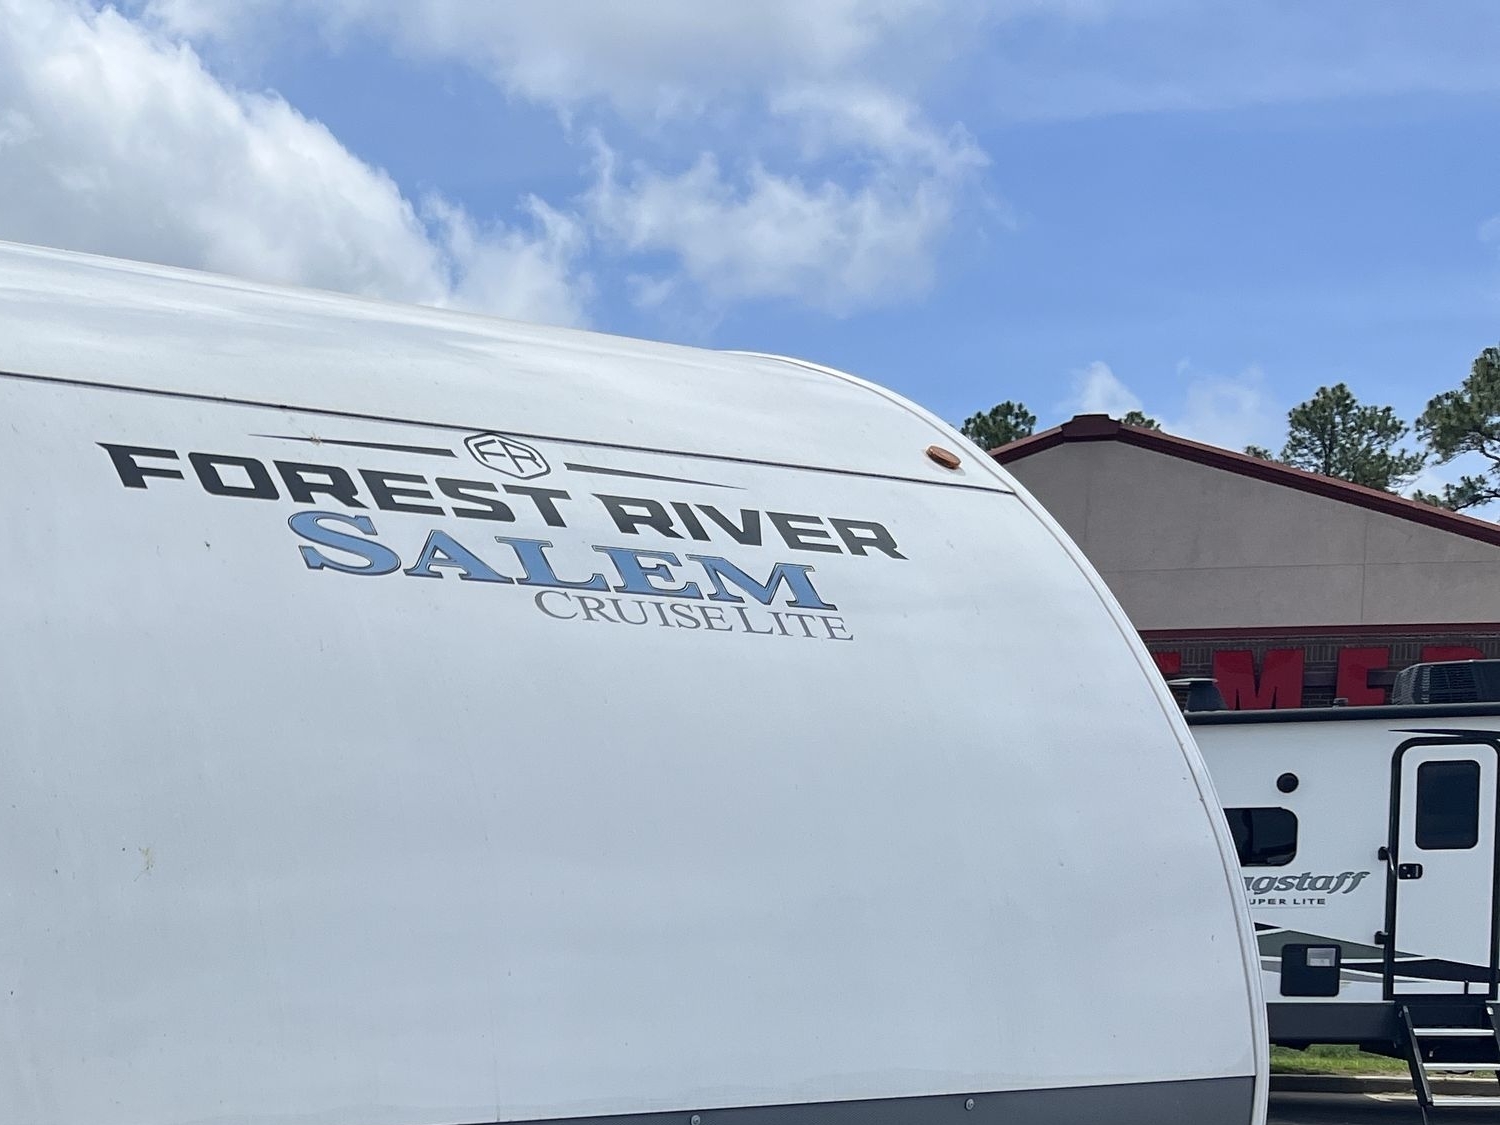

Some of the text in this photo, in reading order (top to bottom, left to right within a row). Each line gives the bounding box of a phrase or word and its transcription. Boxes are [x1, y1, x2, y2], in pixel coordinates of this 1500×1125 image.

[95, 441, 910, 561] FOREST RIVER
[287, 510, 839, 612] SALEM
